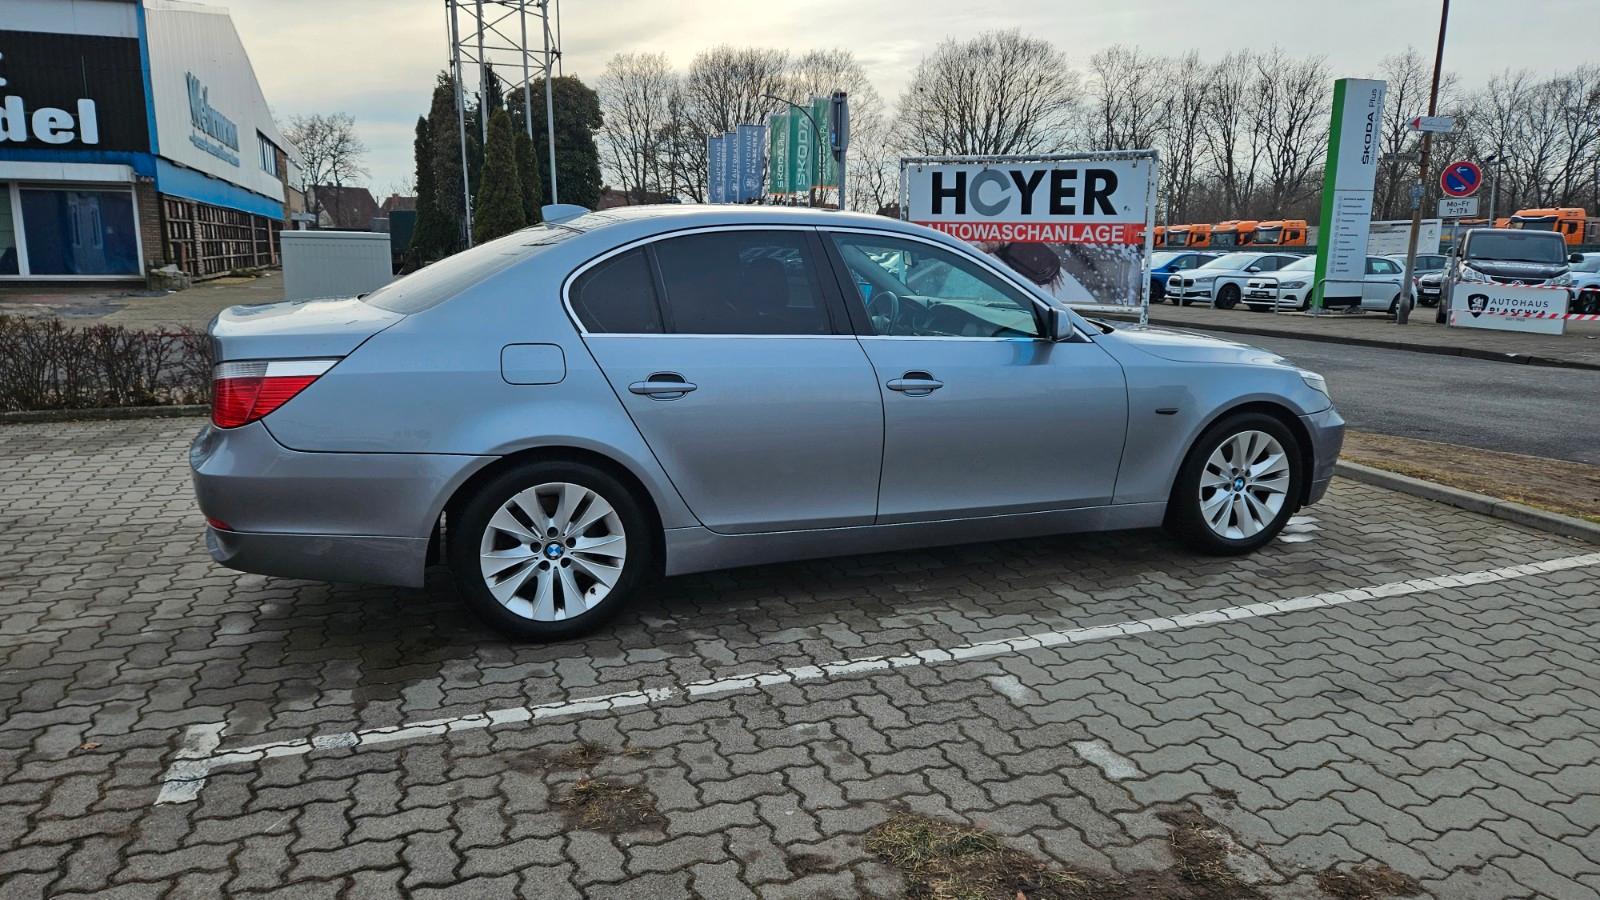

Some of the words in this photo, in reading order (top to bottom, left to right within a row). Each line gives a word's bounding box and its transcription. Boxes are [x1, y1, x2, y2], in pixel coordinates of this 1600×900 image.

[1368, 88, 1378, 107] Plus
[931, 168, 1118, 217] HOYER
[1490, 297, 1550, 308] AUTOHAUS
